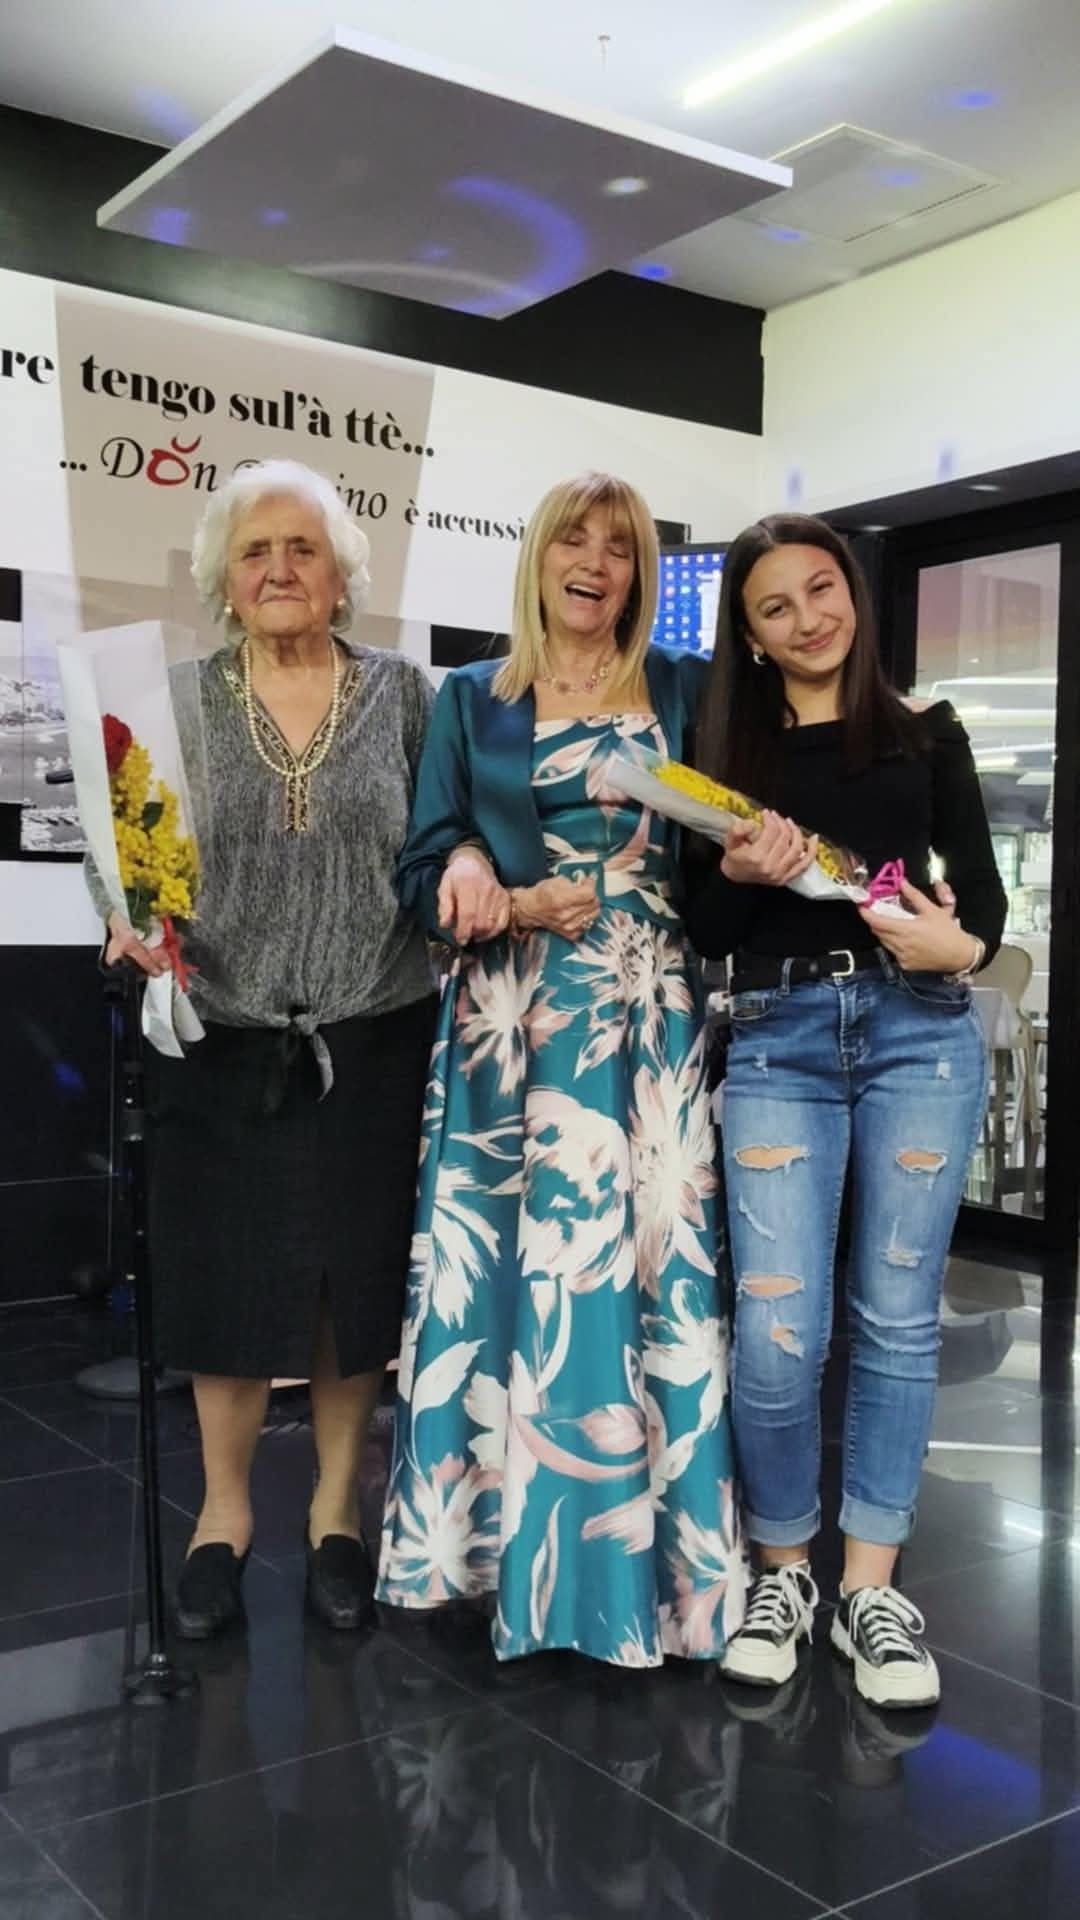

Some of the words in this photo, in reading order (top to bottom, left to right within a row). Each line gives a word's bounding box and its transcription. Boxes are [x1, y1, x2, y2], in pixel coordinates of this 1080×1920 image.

[80, 354, 216, 422] tengo
[345, 407, 434, 458] ttè...
[404, 498, 419, 526] è
